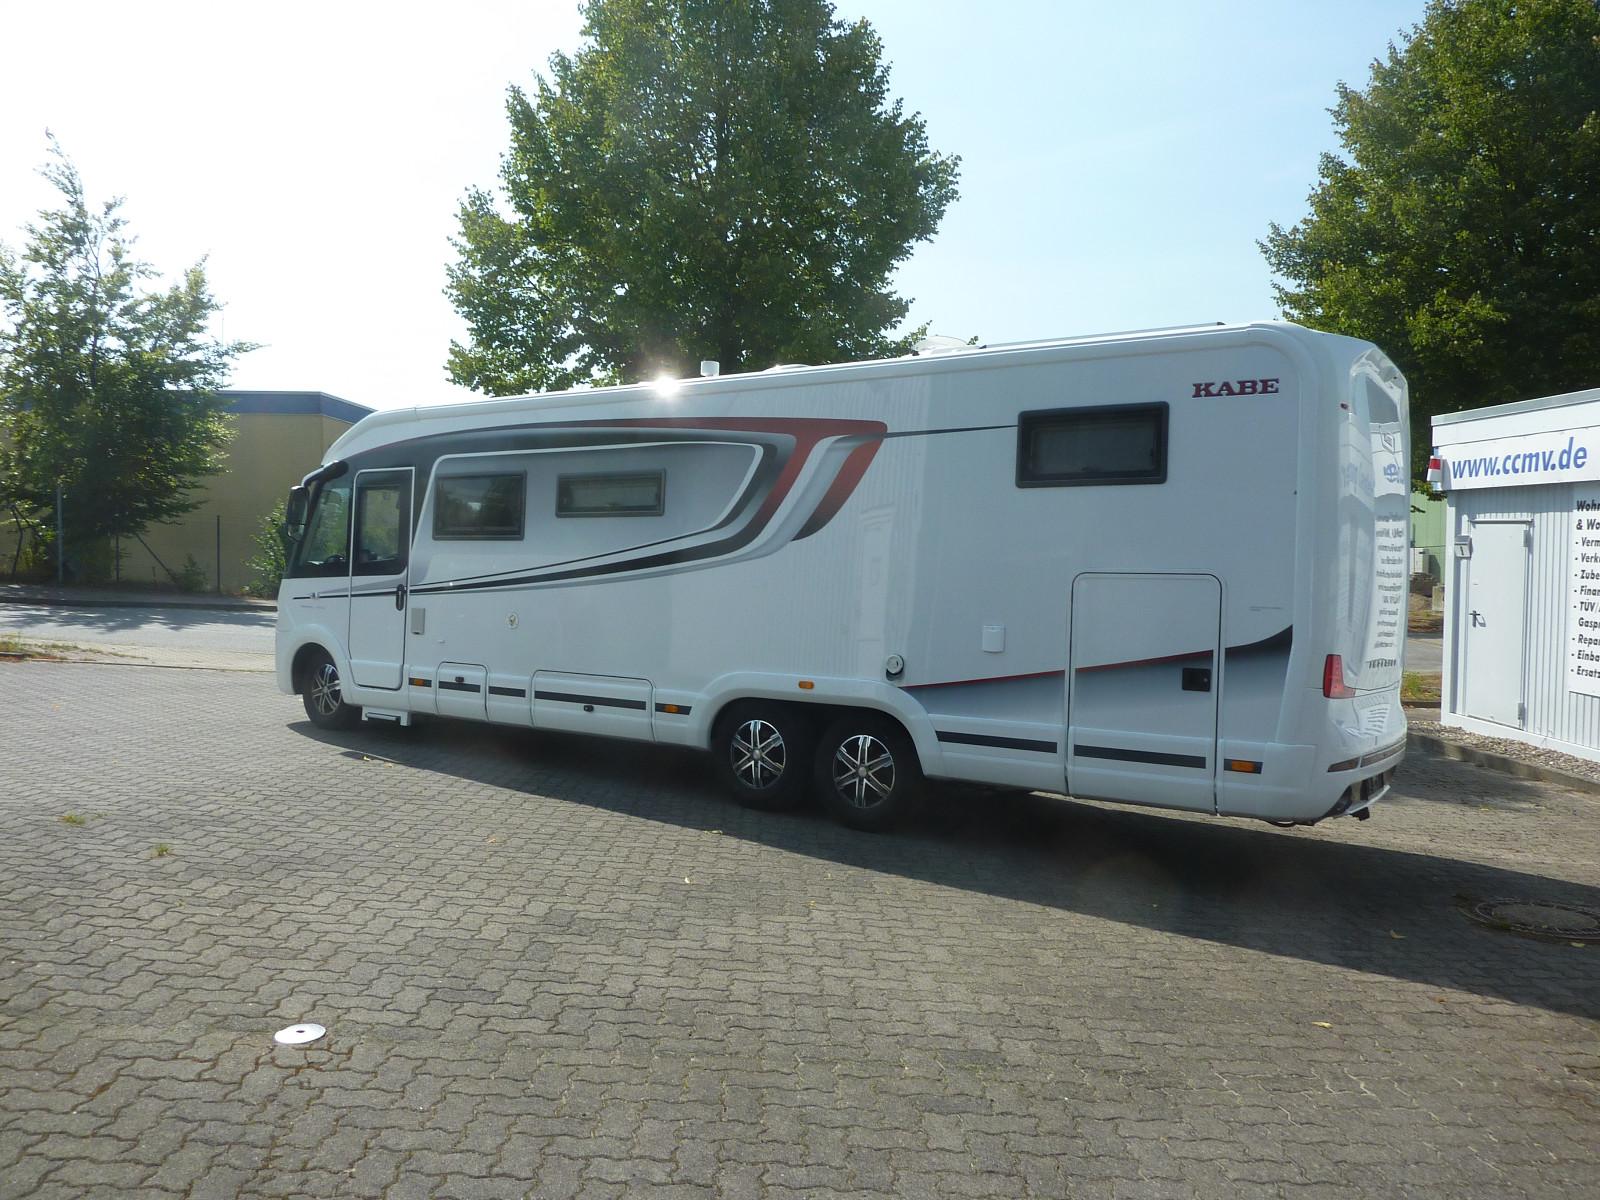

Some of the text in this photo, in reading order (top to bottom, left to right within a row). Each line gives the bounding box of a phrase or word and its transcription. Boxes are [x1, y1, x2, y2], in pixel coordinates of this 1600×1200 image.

[1192, 378, 1280, 398] KABE
[1452, 436, 1588, 479] www.ccmv.de
[1576, 518, 1583, 530] &
